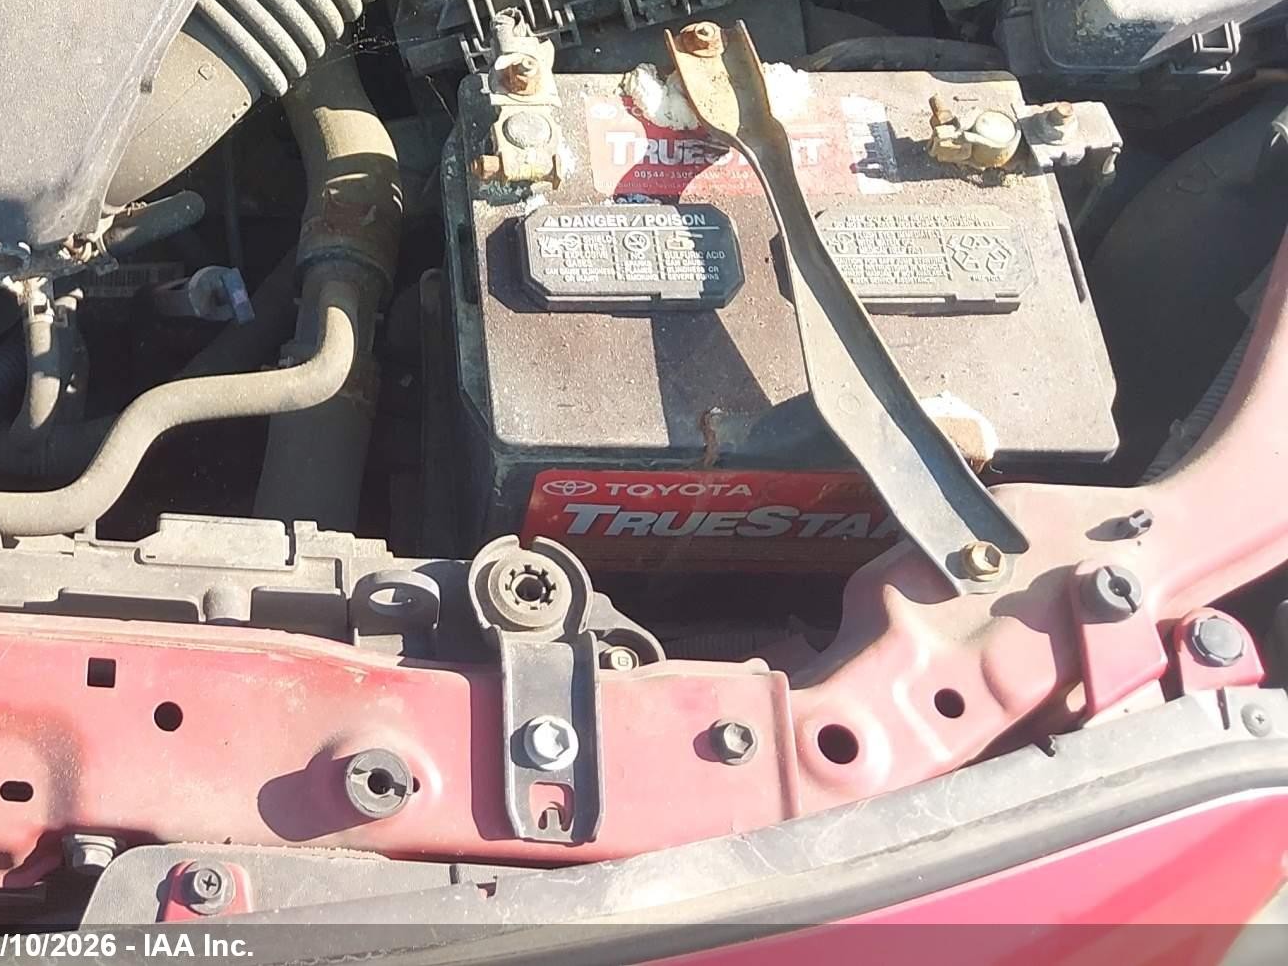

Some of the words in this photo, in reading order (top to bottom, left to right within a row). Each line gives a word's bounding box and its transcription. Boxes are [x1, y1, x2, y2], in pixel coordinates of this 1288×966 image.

[561, 214, 628, 228] DANGER
[645, 214, 706, 227] POISON
[605, 483, 753, 497] TOYOTA
